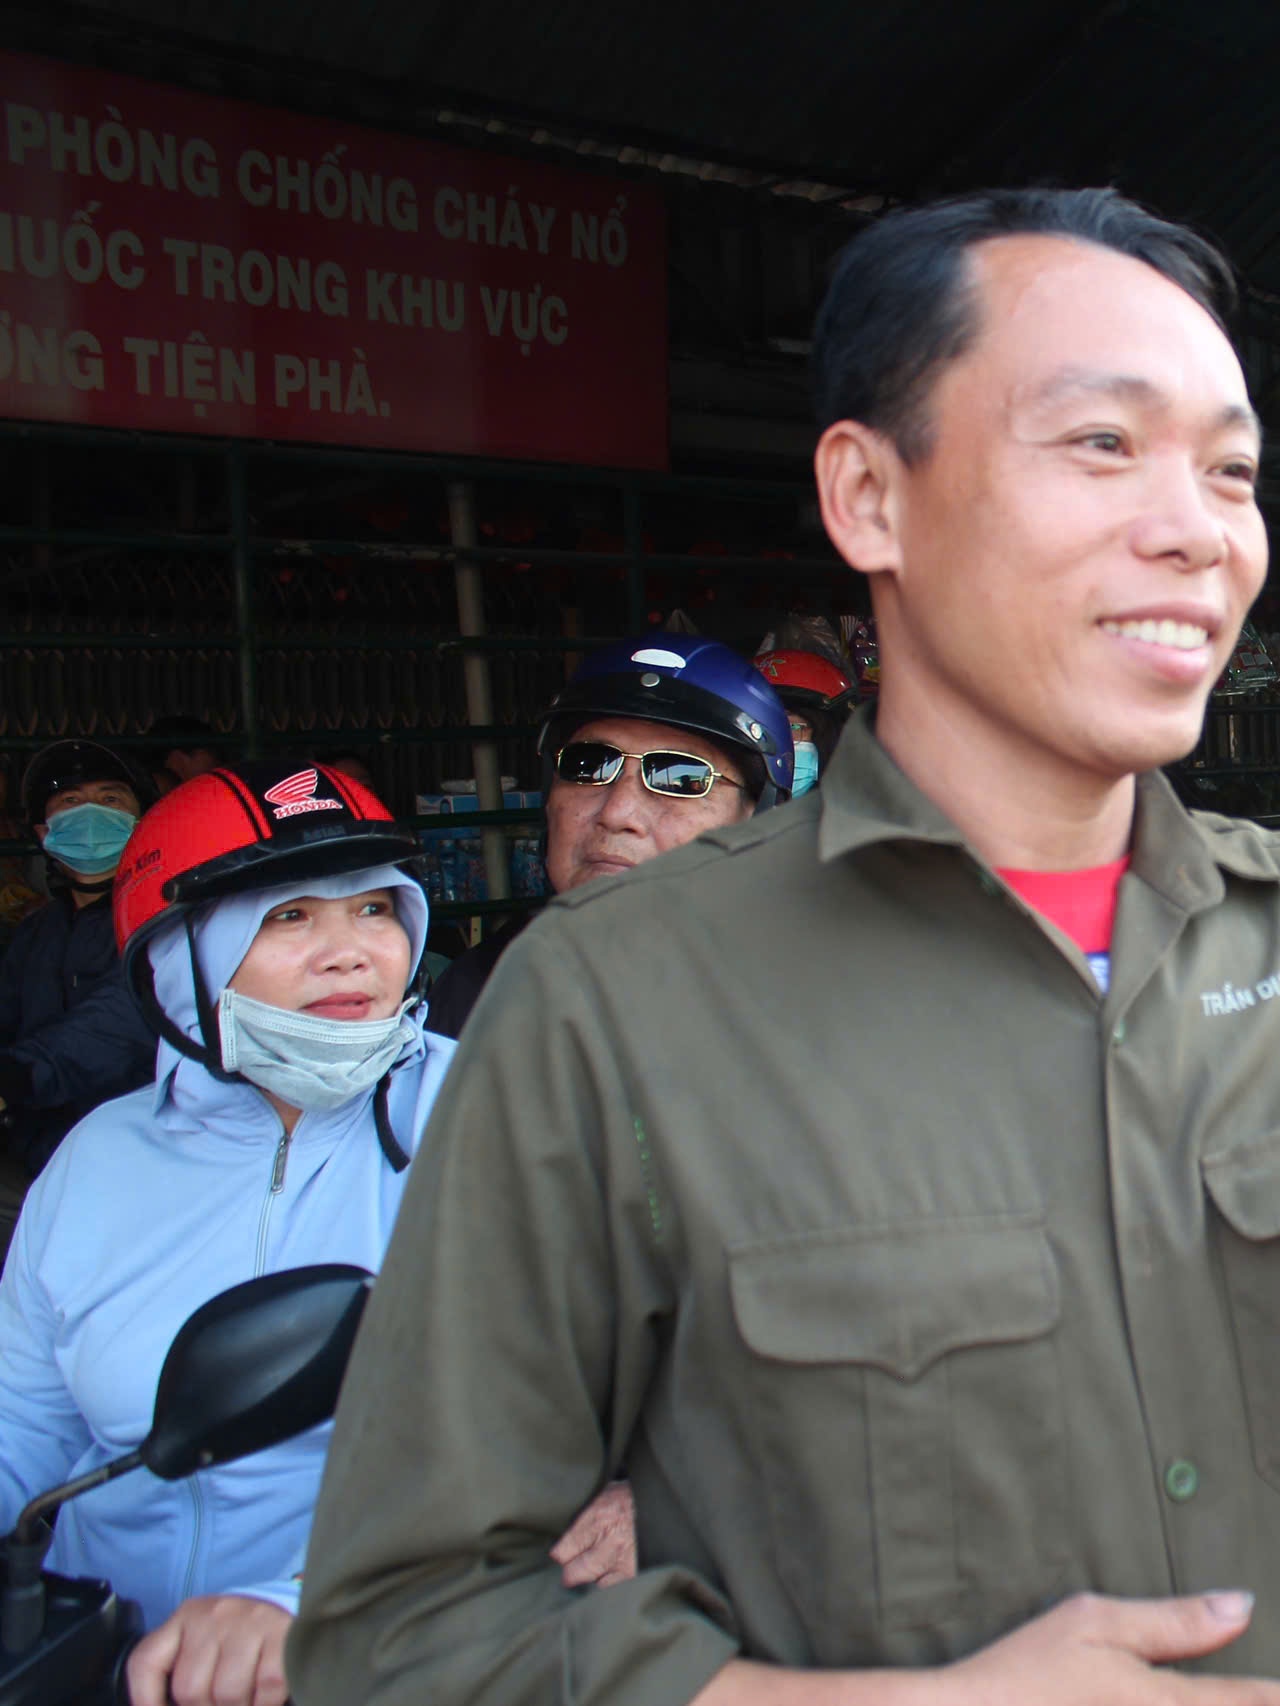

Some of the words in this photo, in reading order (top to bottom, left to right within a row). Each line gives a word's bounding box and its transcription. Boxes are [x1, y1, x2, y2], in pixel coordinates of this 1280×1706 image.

[8, 103, 219, 198] PHÒNG
[237, 143, 420, 232] CHỐNG
[433, 185, 557, 255] CHÁY
[571, 192, 630, 267] NỔ
[162, 237, 349, 317] TRONG
[366, 269, 466, 332] KHU
[480, 282, 569, 356] VỰC
[123, 330, 257, 417] TIỆN
[274, 348, 392, 417] PHÀ.
[272, 799, 343, 819] HONDA
